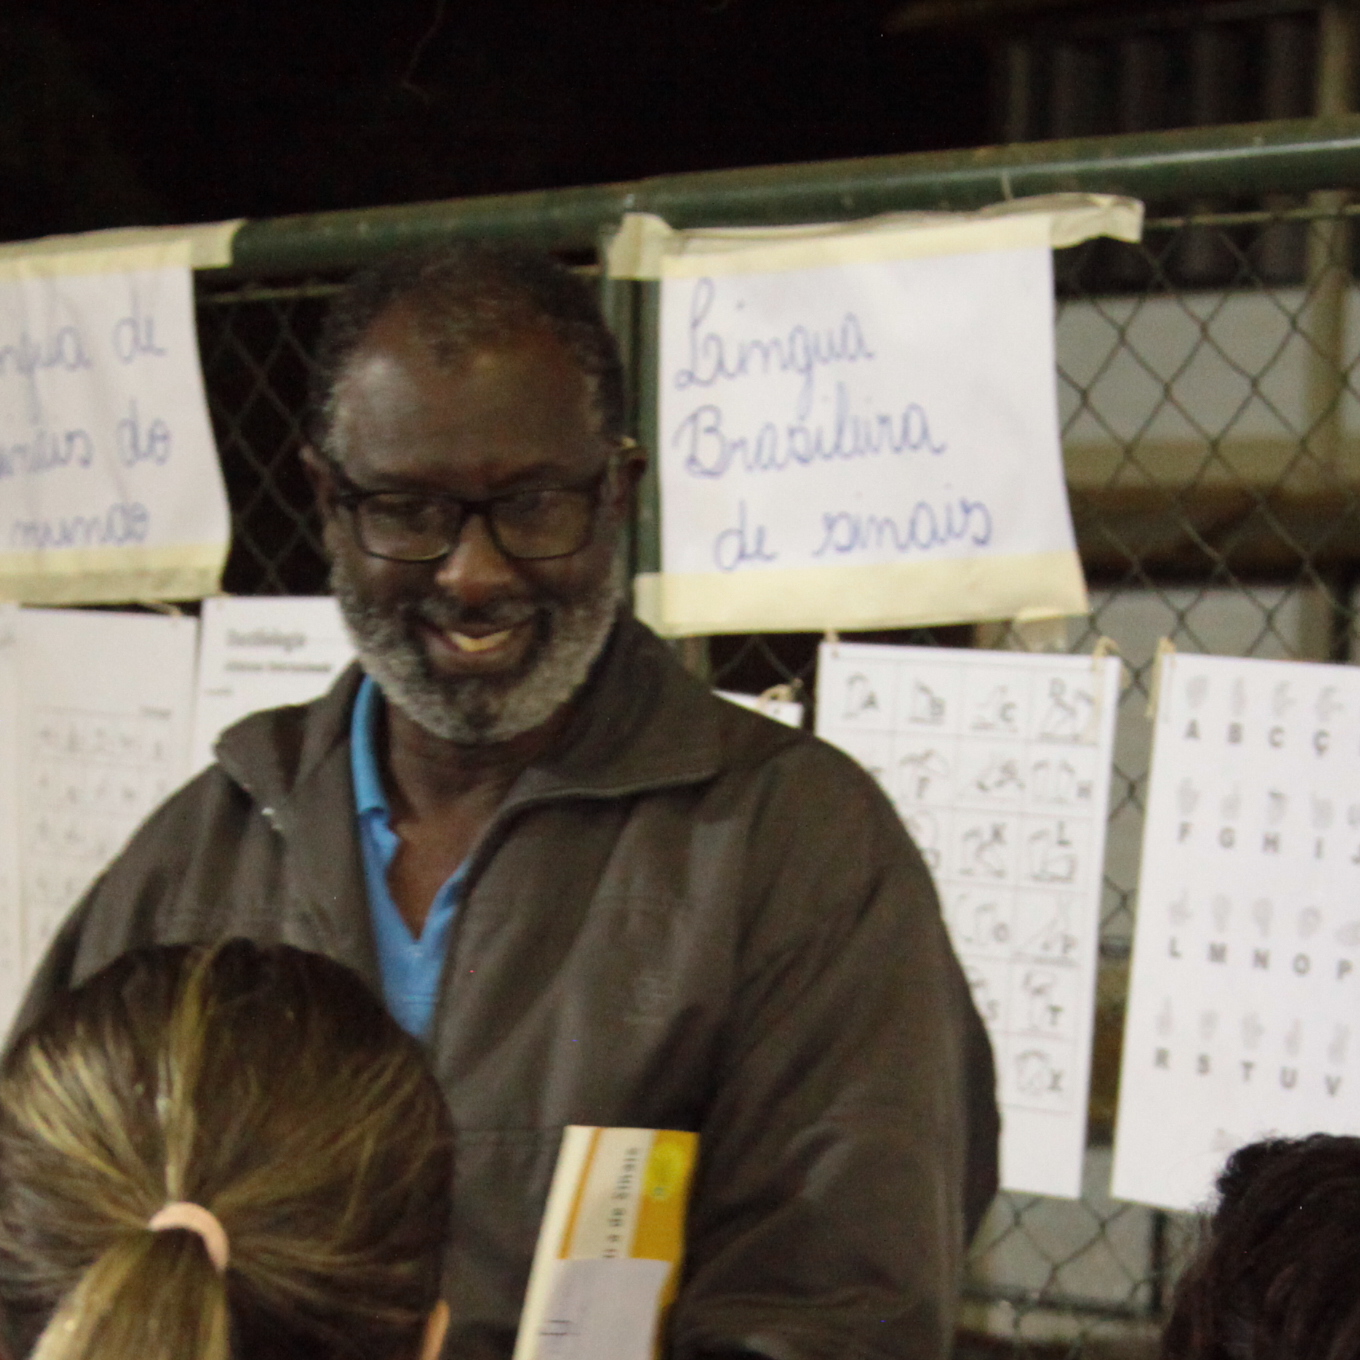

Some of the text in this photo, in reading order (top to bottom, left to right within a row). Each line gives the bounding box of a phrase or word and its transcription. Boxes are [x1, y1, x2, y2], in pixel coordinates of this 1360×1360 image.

[111, 288, 169, 365] de
[115, 398, 172, 468] do
[713, 486, 995, 572] de sinais
[1184, 718, 1201, 740] A
[1227, 723, 1244, 745] B
[1268, 725, 1286, 748] C
[1312, 730, 1330, 756] Ç
[1177, 822, 1193, 844] F
[1218, 826, 1236, 849] G
[1262, 831, 1280, 854] H
[1314, 836, 1324, 860] I
[1168, 936, 1182, 959] L
[1207, 942, 1228, 965] M
[1252, 948, 1270, 970] N
[1292, 952, 1311, 976] O
[1336, 958, 1354, 980] P
[1154, 1047, 1170, 1070] R
[1196, 1053, 1211, 1075] S
[1240, 1061, 1256, 1083] T
[1279, 1066, 1298, 1089] U
[1324, 1075, 1342, 1097] V
